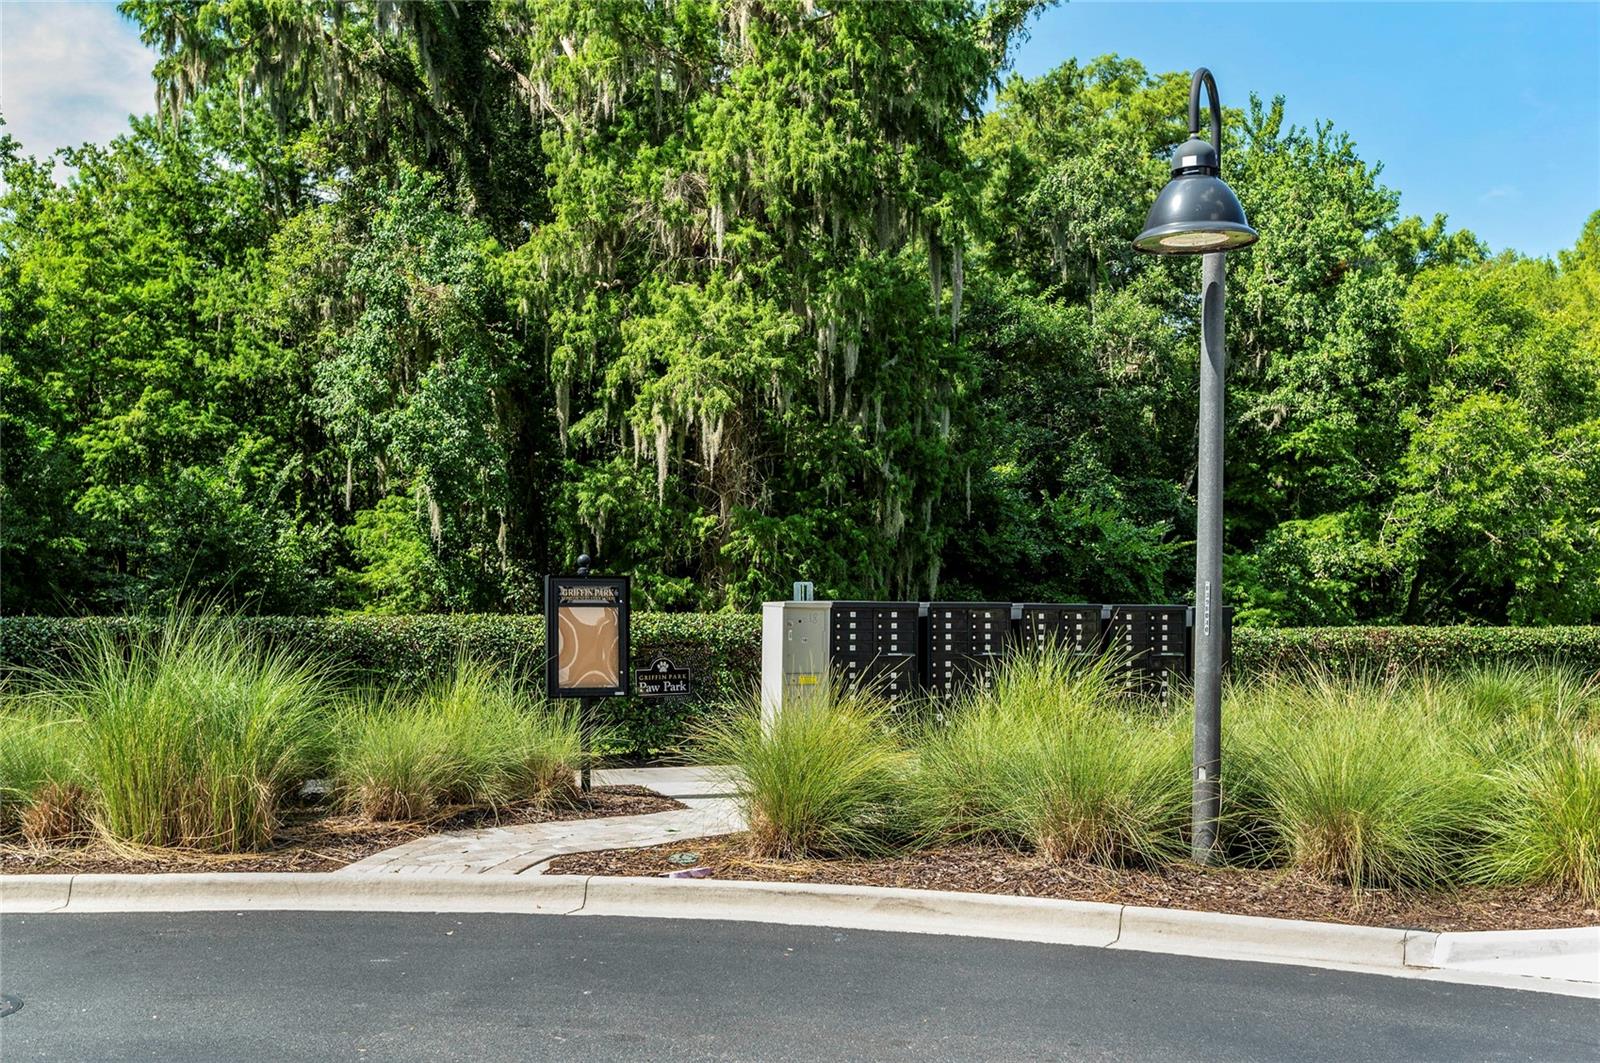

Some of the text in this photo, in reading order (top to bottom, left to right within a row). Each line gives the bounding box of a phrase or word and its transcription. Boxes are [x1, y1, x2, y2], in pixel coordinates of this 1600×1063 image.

[562, 588, 614, 597] GRIFFIN PARK
[638, 680, 687, 693] Paw Park
